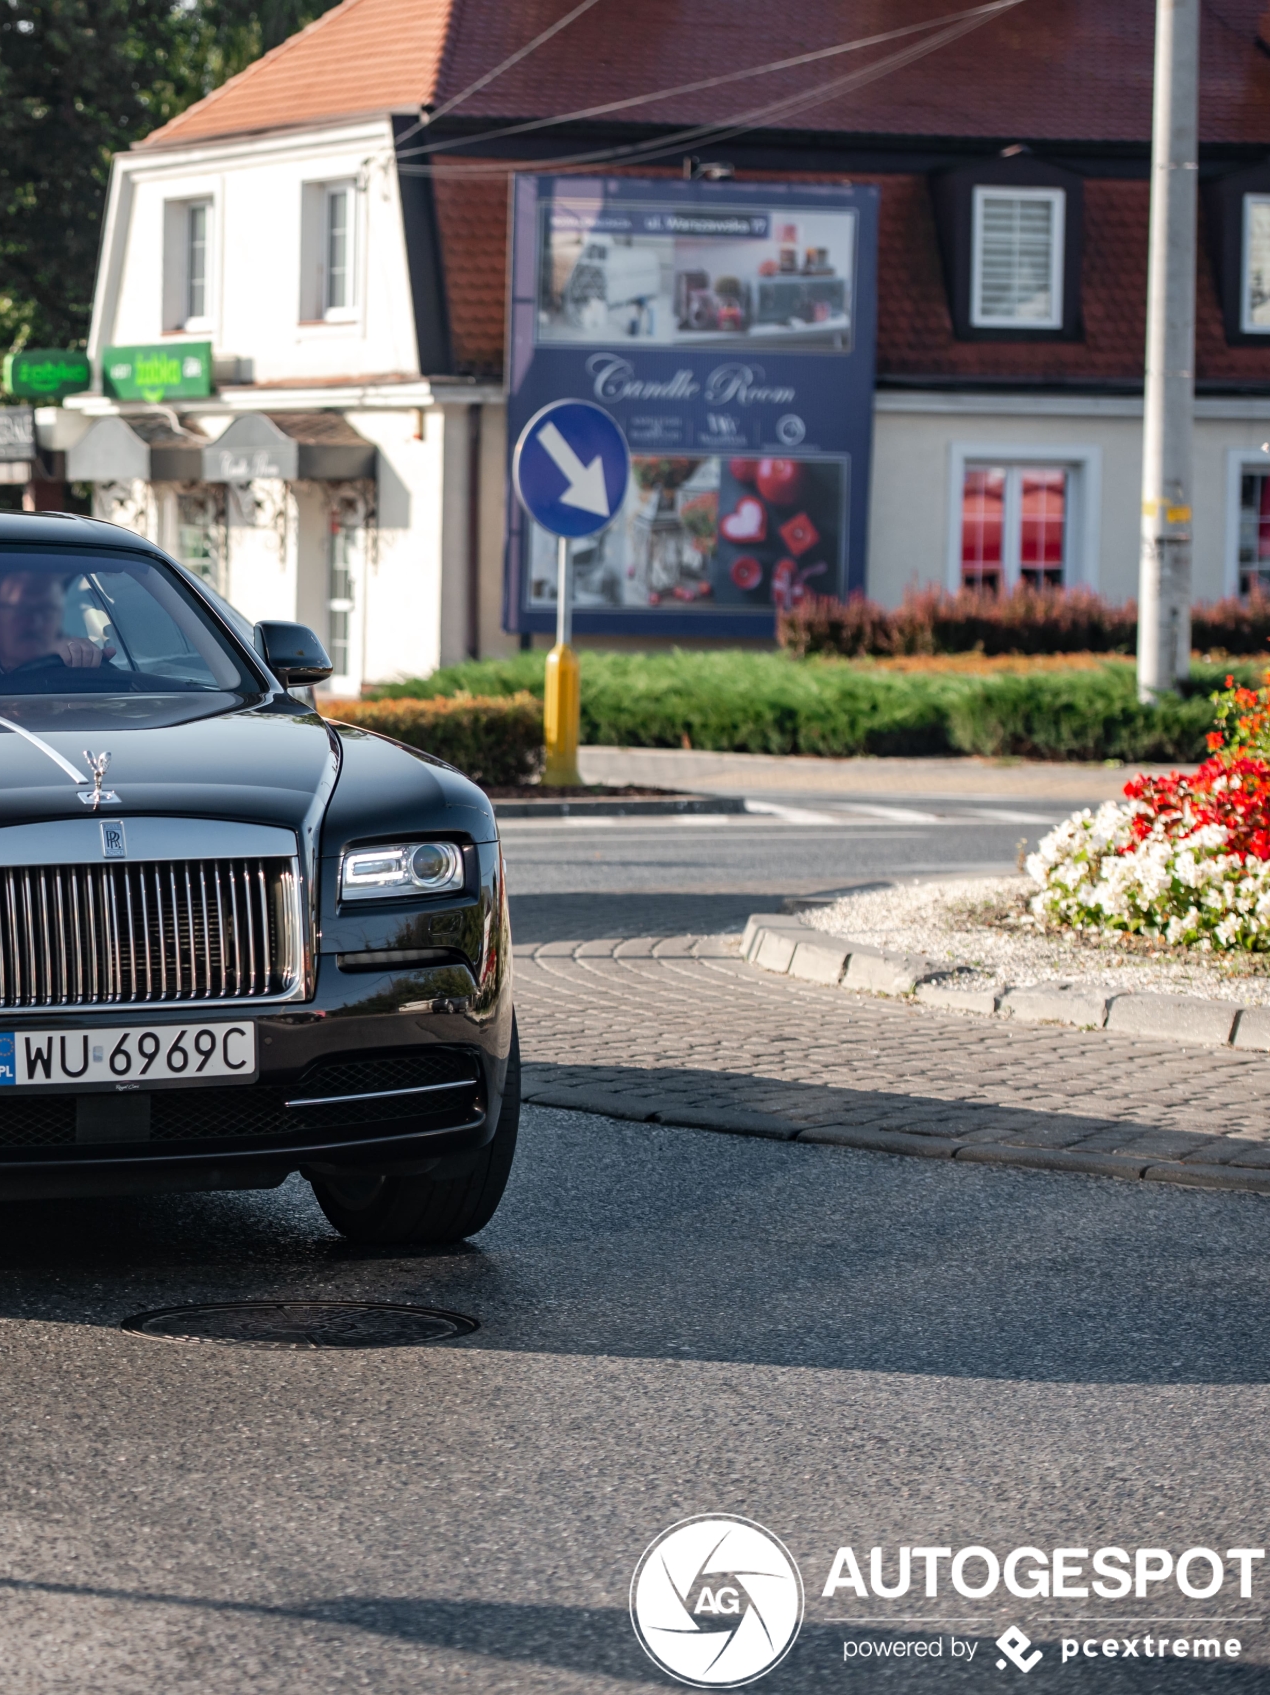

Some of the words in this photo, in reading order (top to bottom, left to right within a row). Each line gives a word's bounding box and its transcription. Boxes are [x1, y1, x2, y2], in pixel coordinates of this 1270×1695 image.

[585, 352, 700, 404] Candle
[704, 362, 796, 407] Room
[24, 1035, 89, 1080] WU
[109, 1027, 247, 1076] 6969C
